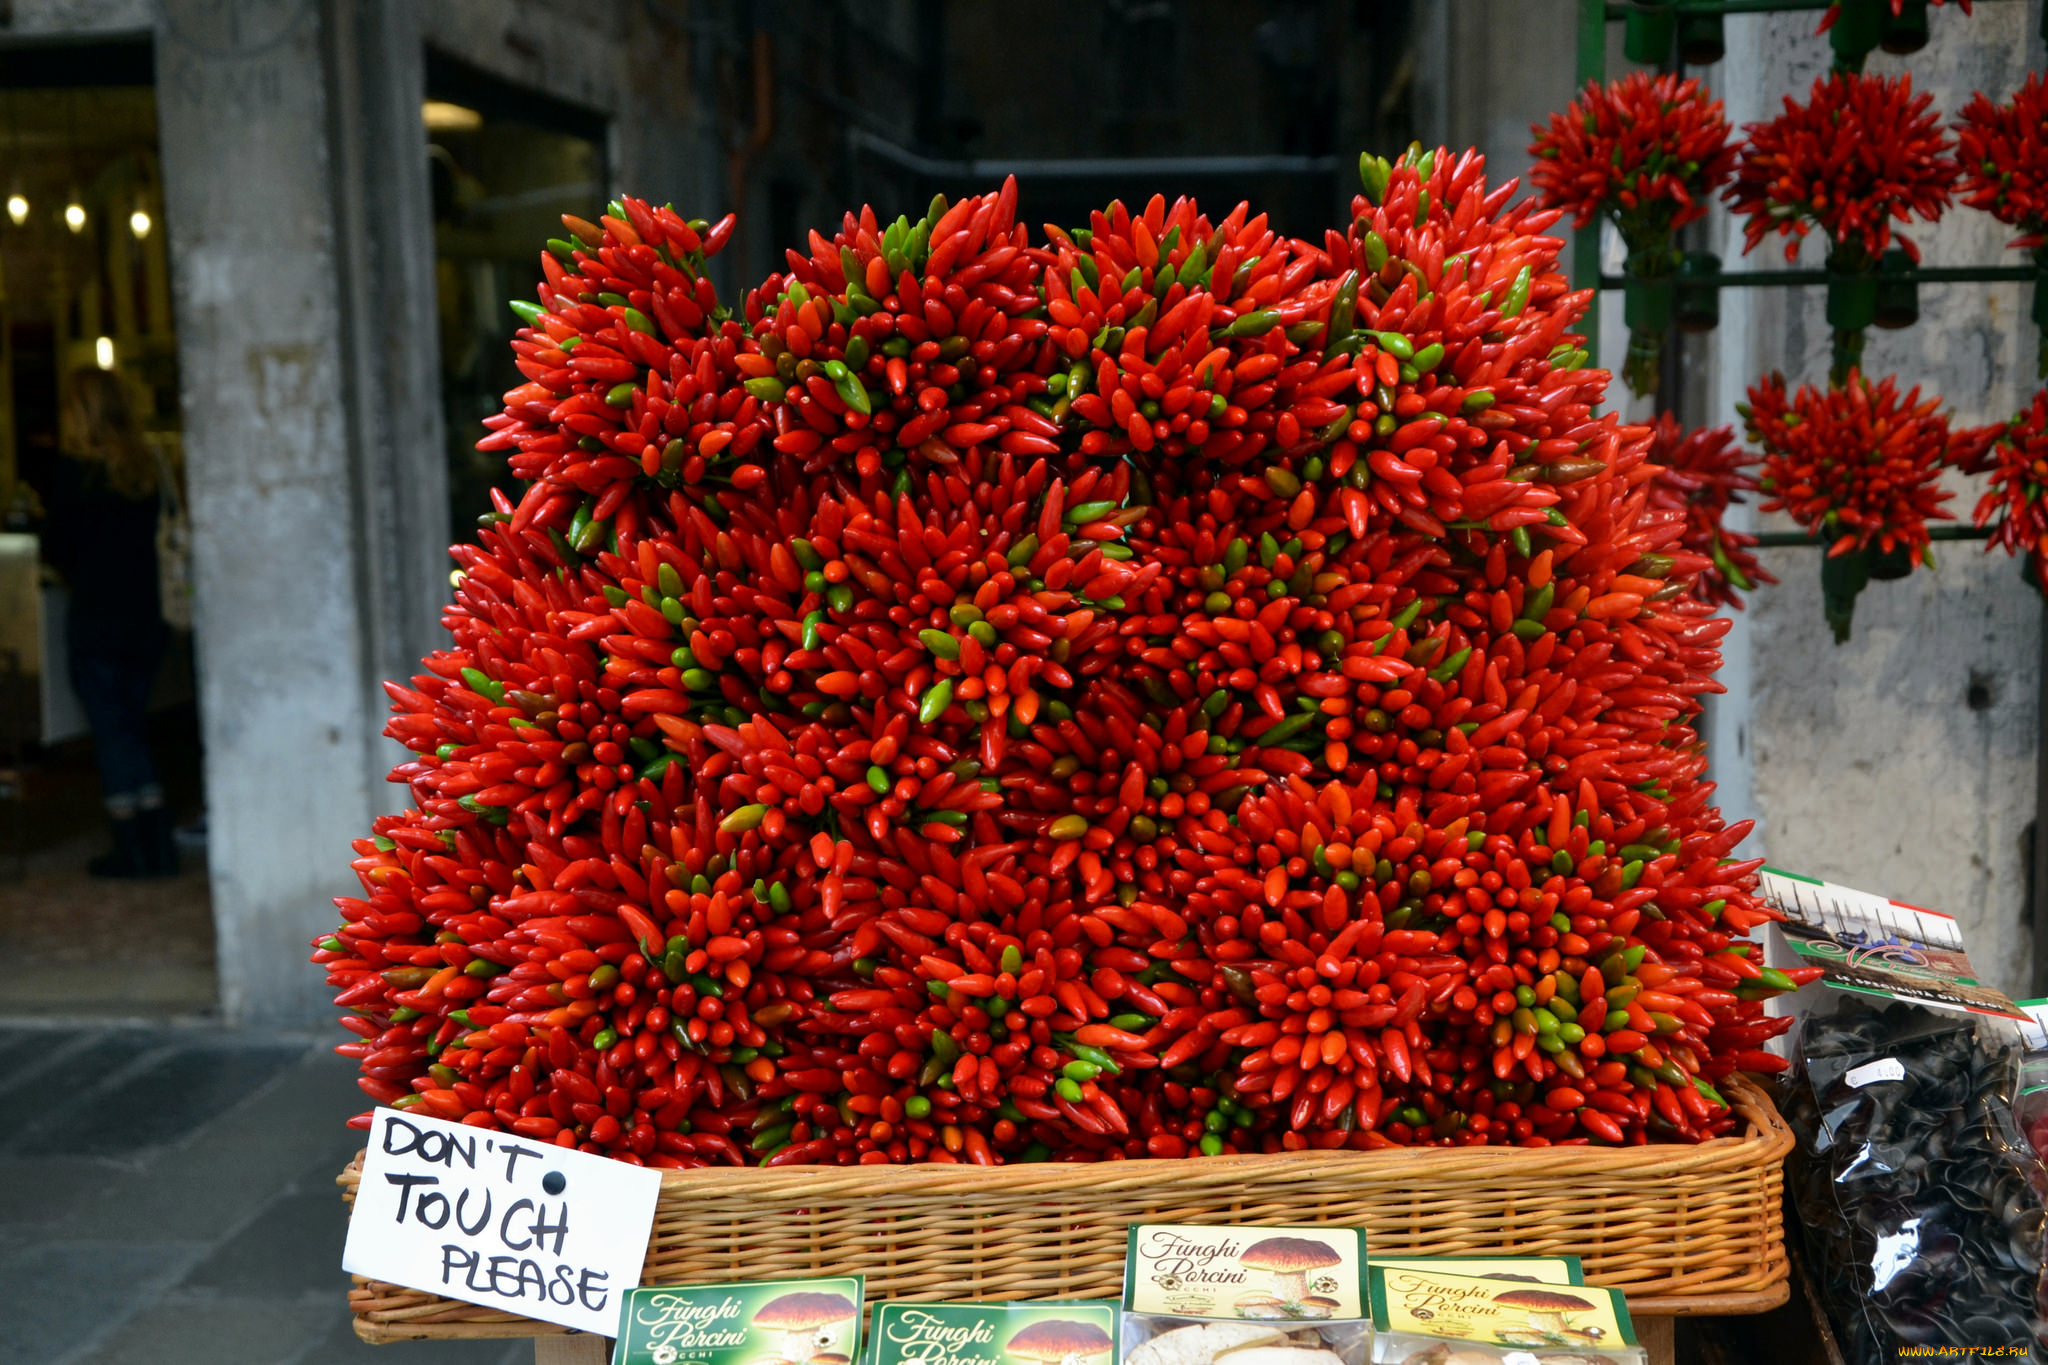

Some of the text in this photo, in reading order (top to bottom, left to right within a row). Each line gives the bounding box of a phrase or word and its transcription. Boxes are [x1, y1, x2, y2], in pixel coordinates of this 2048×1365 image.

[382, 1116, 544, 1184] DON'T
[384, 1172, 569, 1256] TOUCH
[1139, 1231, 1240, 1266] Funghi
[441, 1244, 609, 1312] PLEASE
[1151, 1257, 1248, 1285] Porcini
[1388, 1274, 1491, 1302] Funghi
[637, 1293, 742, 1329] Funghi
[1403, 1292, 1501, 1317] Porcini
[646, 1320, 748, 1351] Porcini
[887, 1310, 995, 1353] Funghi
[897, 1340, 1001, 1365] Porcini
